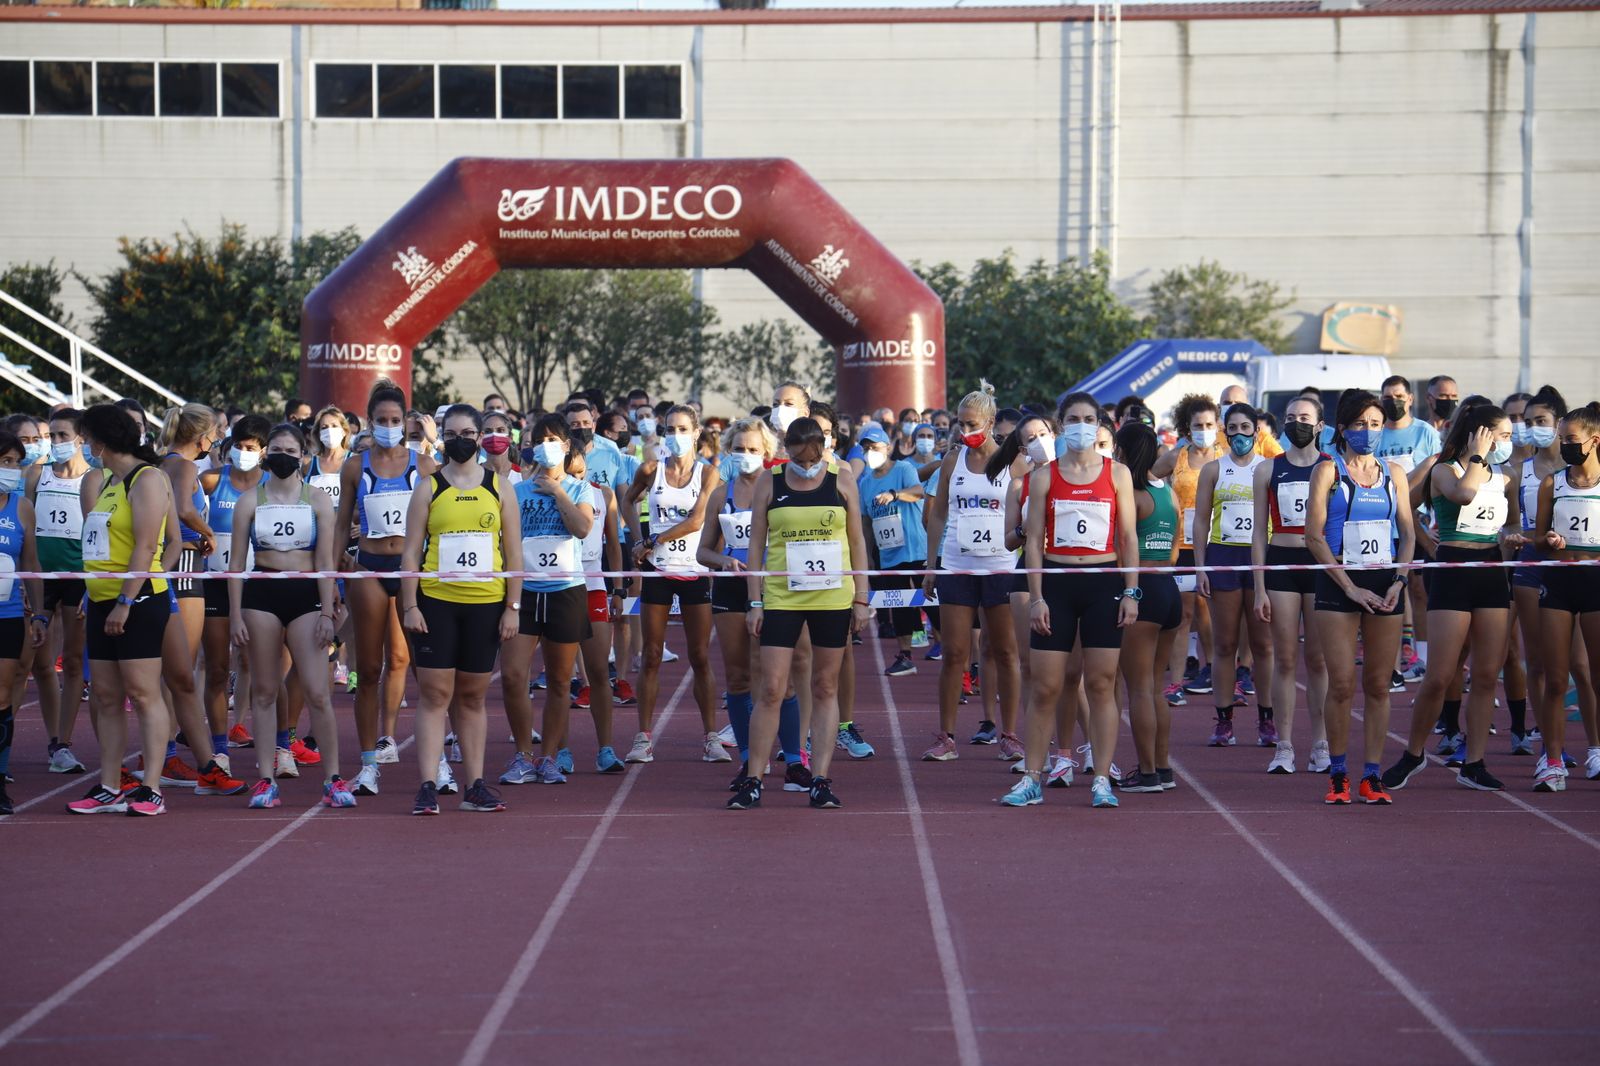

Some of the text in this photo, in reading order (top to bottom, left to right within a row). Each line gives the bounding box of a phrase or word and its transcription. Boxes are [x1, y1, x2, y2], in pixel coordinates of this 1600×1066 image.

[555, 185, 742, 220] IMDECO
[499, 227, 740, 241] Instituto Municipal de Deportes Córdoba
[765, 238, 859, 327] AYUNTAMIENTO DE CÓRDOBA
[325, 343, 402, 363] IMDECO
[1177, 351, 1228, 362] MEDICO
[1129, 355, 1174, 392] PUESTO
[956, 495, 999, 510] indea
[49, 510, 67, 524] 13
[383, 510, 402, 525] 12
[656, 504, 690, 518] inde
[1476, 507, 1495, 520] 25
[273, 521, 294, 536] 26
[1077, 519, 1087, 534] 6
[1235, 517, 1252, 531] 23
[1569, 516, 1589, 532] 21
[735, 524, 751, 539] 36
[782, 529, 833, 538] CLUB ATLETISMO
[879, 527, 896, 539] 191
[973, 530, 992, 543] 24
[668, 540, 687, 552] 38
[1361, 539, 1378, 554] 20
[456, 552, 478, 567] 48
[538, 553, 558, 567] 32
[805, 560, 825, 572] 33
[882, 598, 904, 606] POLICIA
